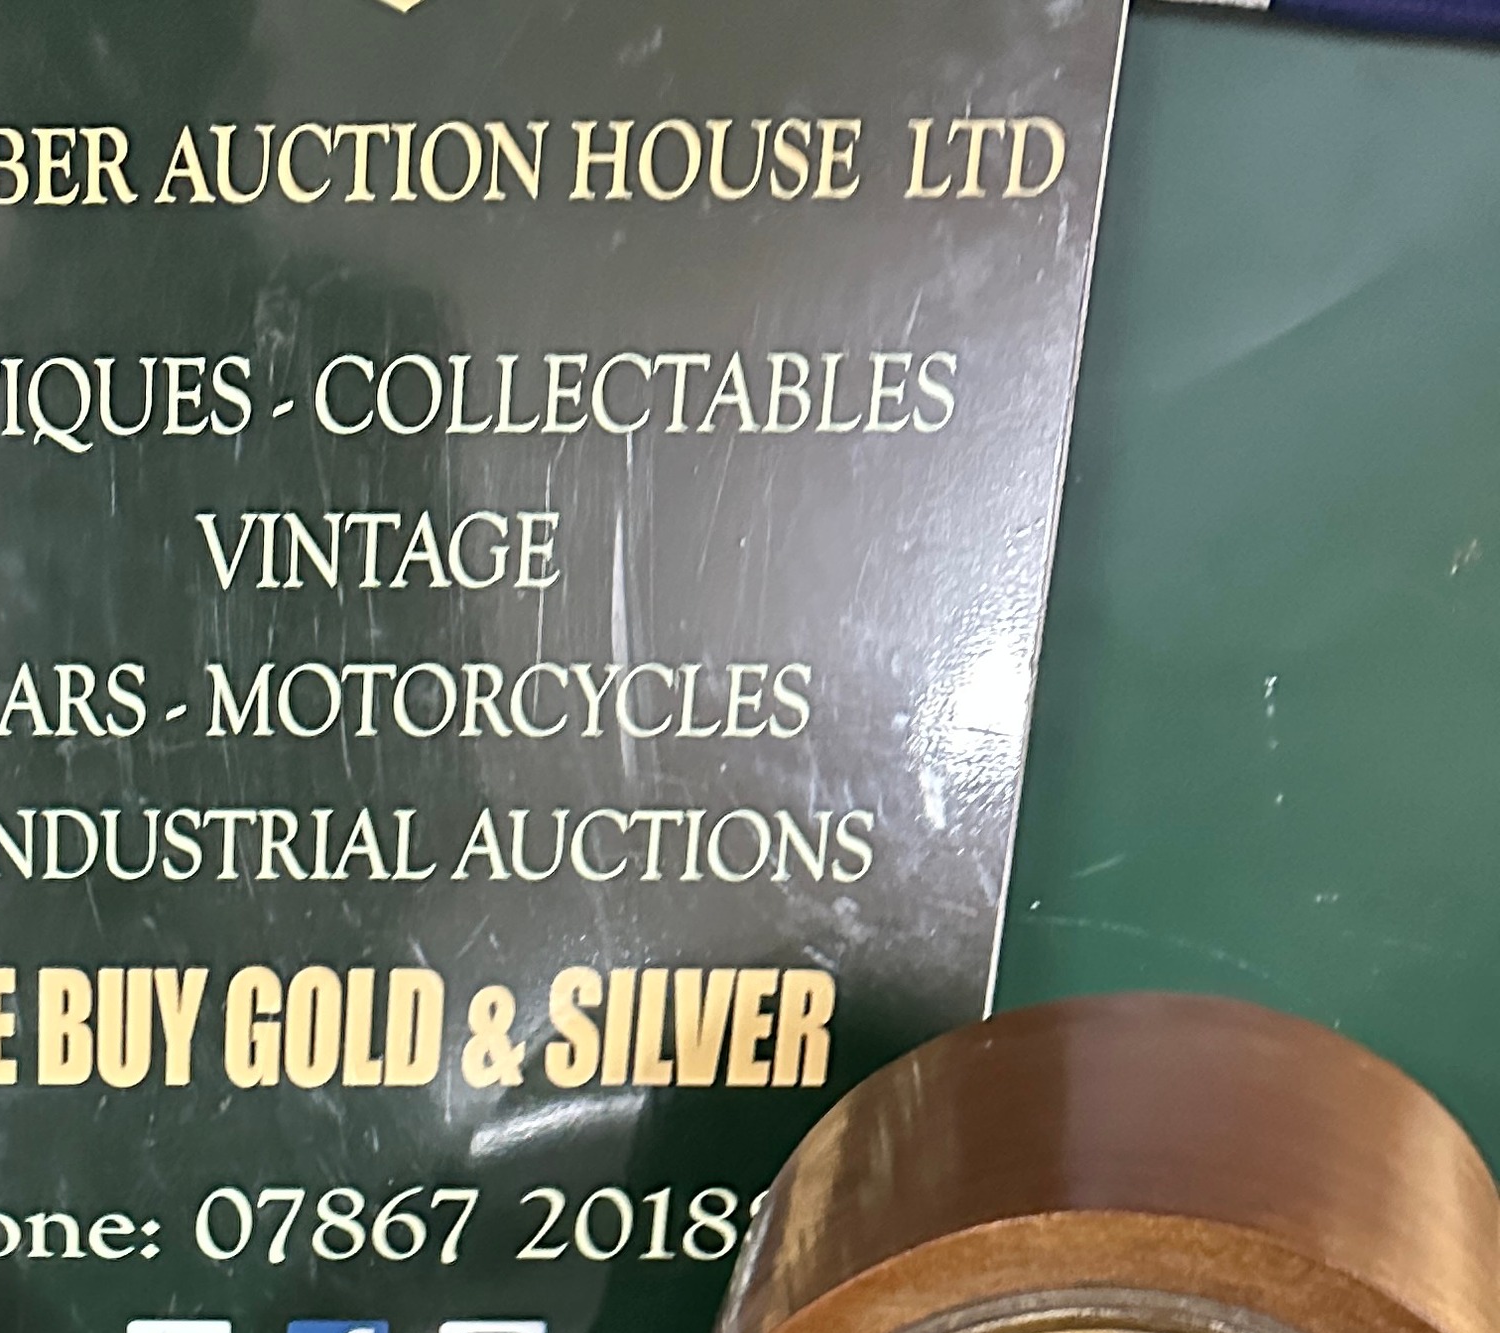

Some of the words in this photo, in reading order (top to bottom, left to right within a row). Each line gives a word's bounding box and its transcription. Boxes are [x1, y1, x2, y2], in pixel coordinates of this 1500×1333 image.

[154, 121, 546, 204] AUCTION
[569, 118, 862, 201] HOUSE
[903, 116, 1067, 199] LTD
[315, 353, 958, 436] COLLECTABLES
[196, 511, 561, 590] VINTAGE
[205, 662, 813, 738] MOTORCYCLES
[450, 808, 876, 882] AUCTIONS
[37, 966, 209, 1088] BUY
[224, 965, 445, 1089] GOLD
[460, 985, 525, 1089] &
[543, 965, 836, 1088] SILVER
[195, 1186, 479, 1265] 07867
[516, 1186, 770, 1264] 2018
